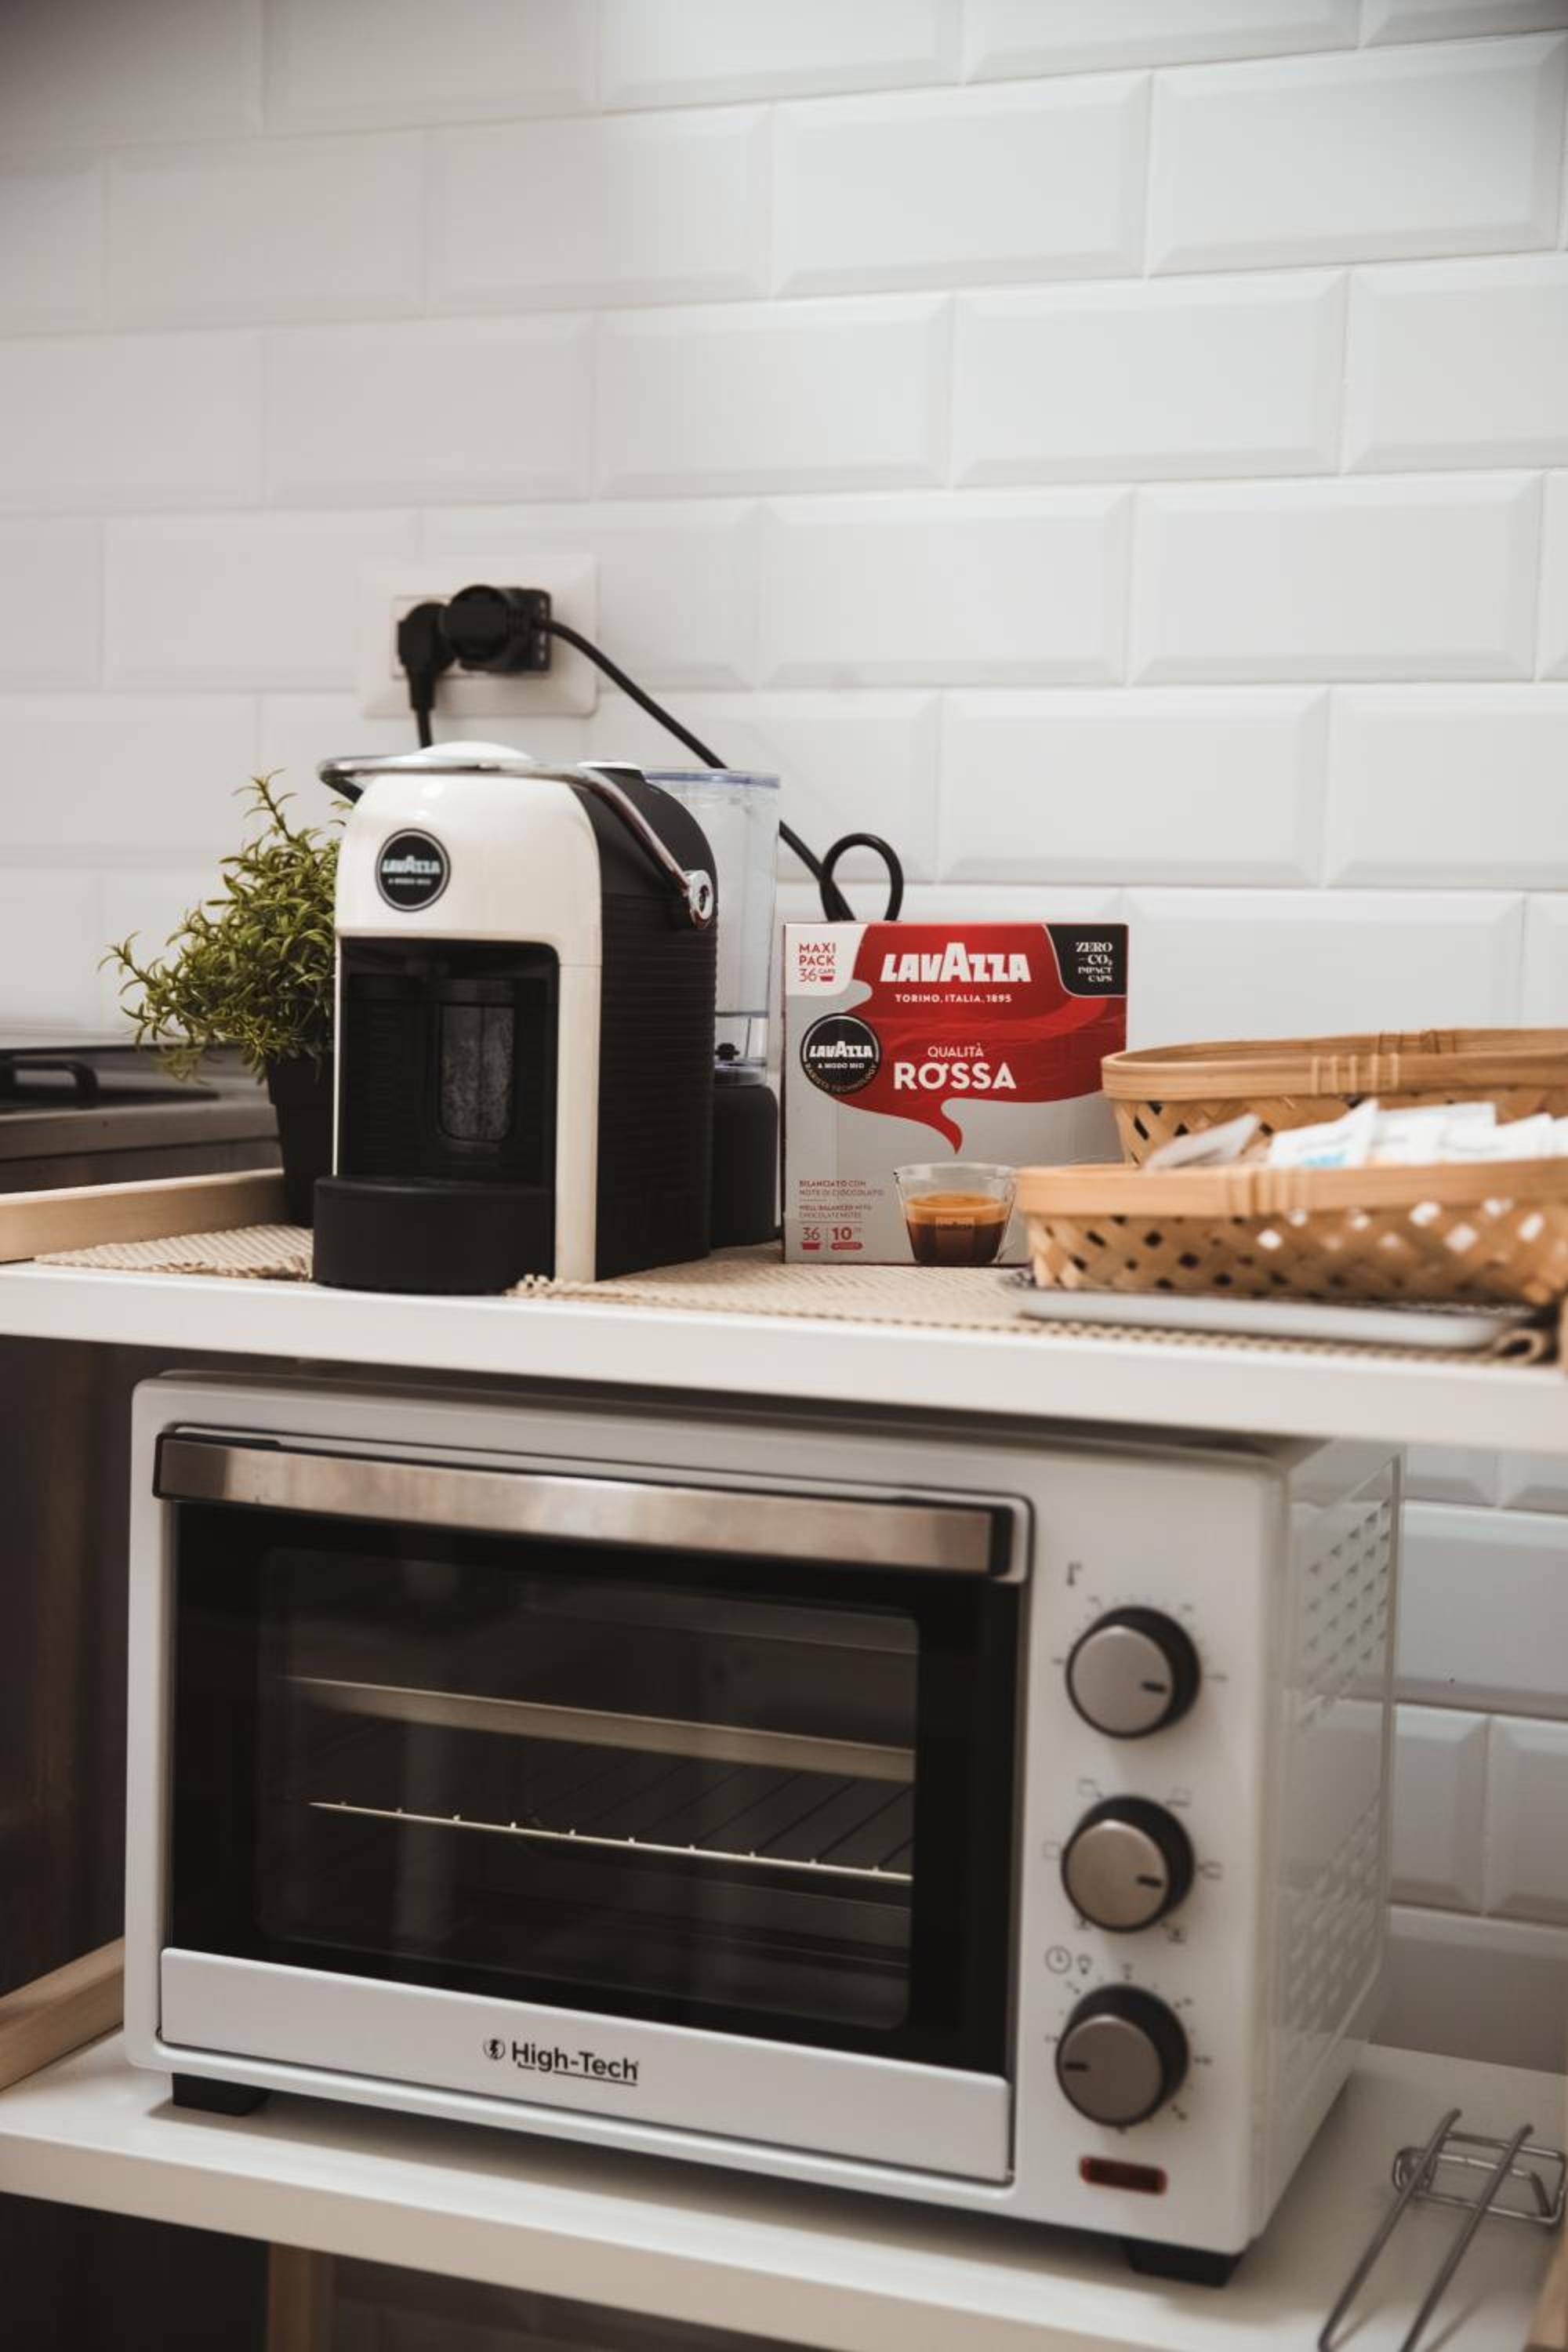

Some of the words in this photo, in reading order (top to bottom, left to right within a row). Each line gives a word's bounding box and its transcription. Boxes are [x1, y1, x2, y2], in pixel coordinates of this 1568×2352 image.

[799, 942, 836, 953] MAXI
[1076, 942, 1112, 952] ZERO
[799, 955, 835, 966] PACK
[880, 942, 1032, 982] LAVAZZA
[799, 968, 816, 982] 36
[986, 994, 1011, 1003] 1895
[809, 1041, 873, 1058] LAVAZZA
[927, 1043, 984, 1058] QUALITÀ
[894, 1062, 1017, 1090] ROSSA
[802, 1227, 821, 1240] 36
[831, 1227, 852, 1240] 10
[512, 2041, 638, 2082] High-Tech
